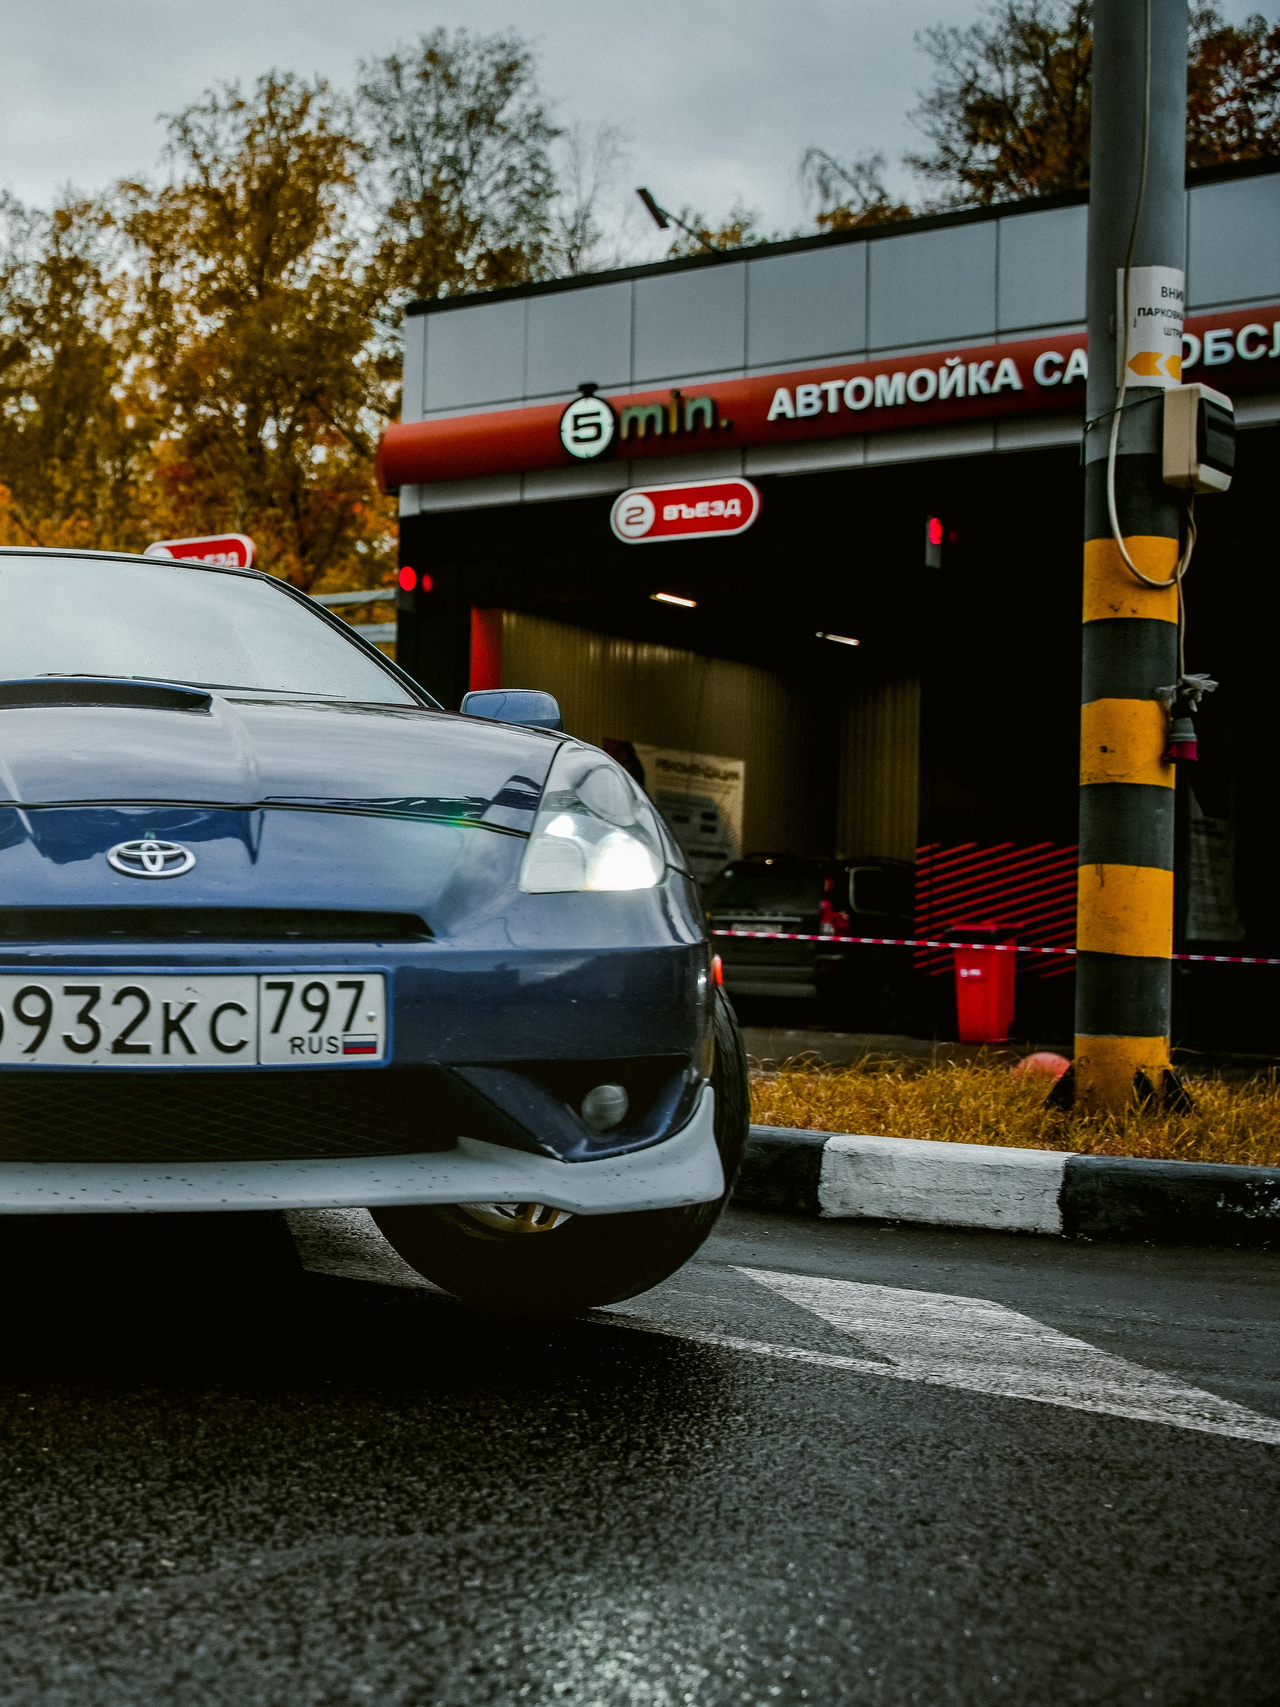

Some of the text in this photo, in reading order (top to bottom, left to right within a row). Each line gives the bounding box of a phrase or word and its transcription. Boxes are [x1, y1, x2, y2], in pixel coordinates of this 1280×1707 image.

[767, 356, 1023, 421] АВТОМОЙКА
[572, 411, 602, 443] 5
[625, 498, 742, 526] 2 ВЪЕЗД
[265, 981, 365, 1034] 797
[290, 1036, 340, 1055] RUS
